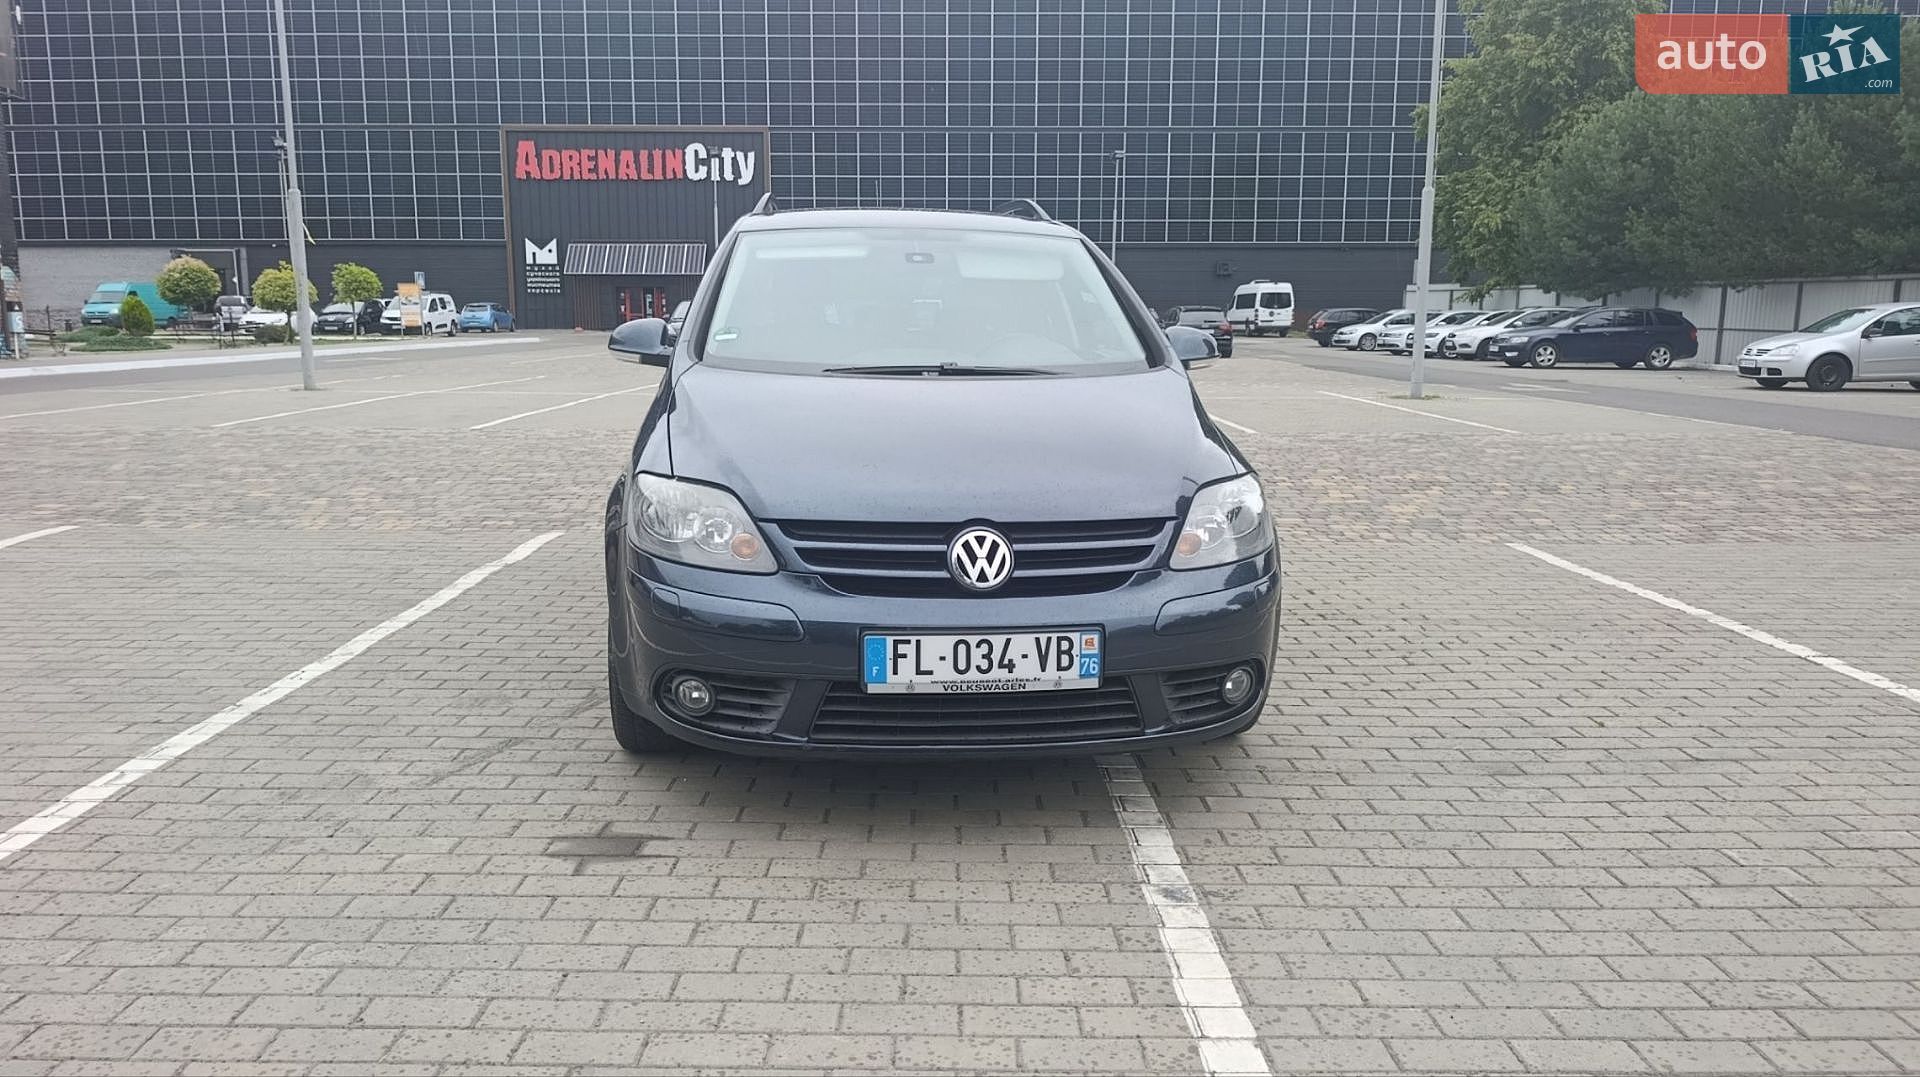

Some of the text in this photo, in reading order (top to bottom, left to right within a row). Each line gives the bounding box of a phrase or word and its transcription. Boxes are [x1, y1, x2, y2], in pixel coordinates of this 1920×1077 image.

[892, 635, 1075, 676] FL-034-VB
[872, 666, 880, 678] F
[1080, 657, 1099, 675] 76
[942, 683, 1027, 692] VOLKSWAGEN
